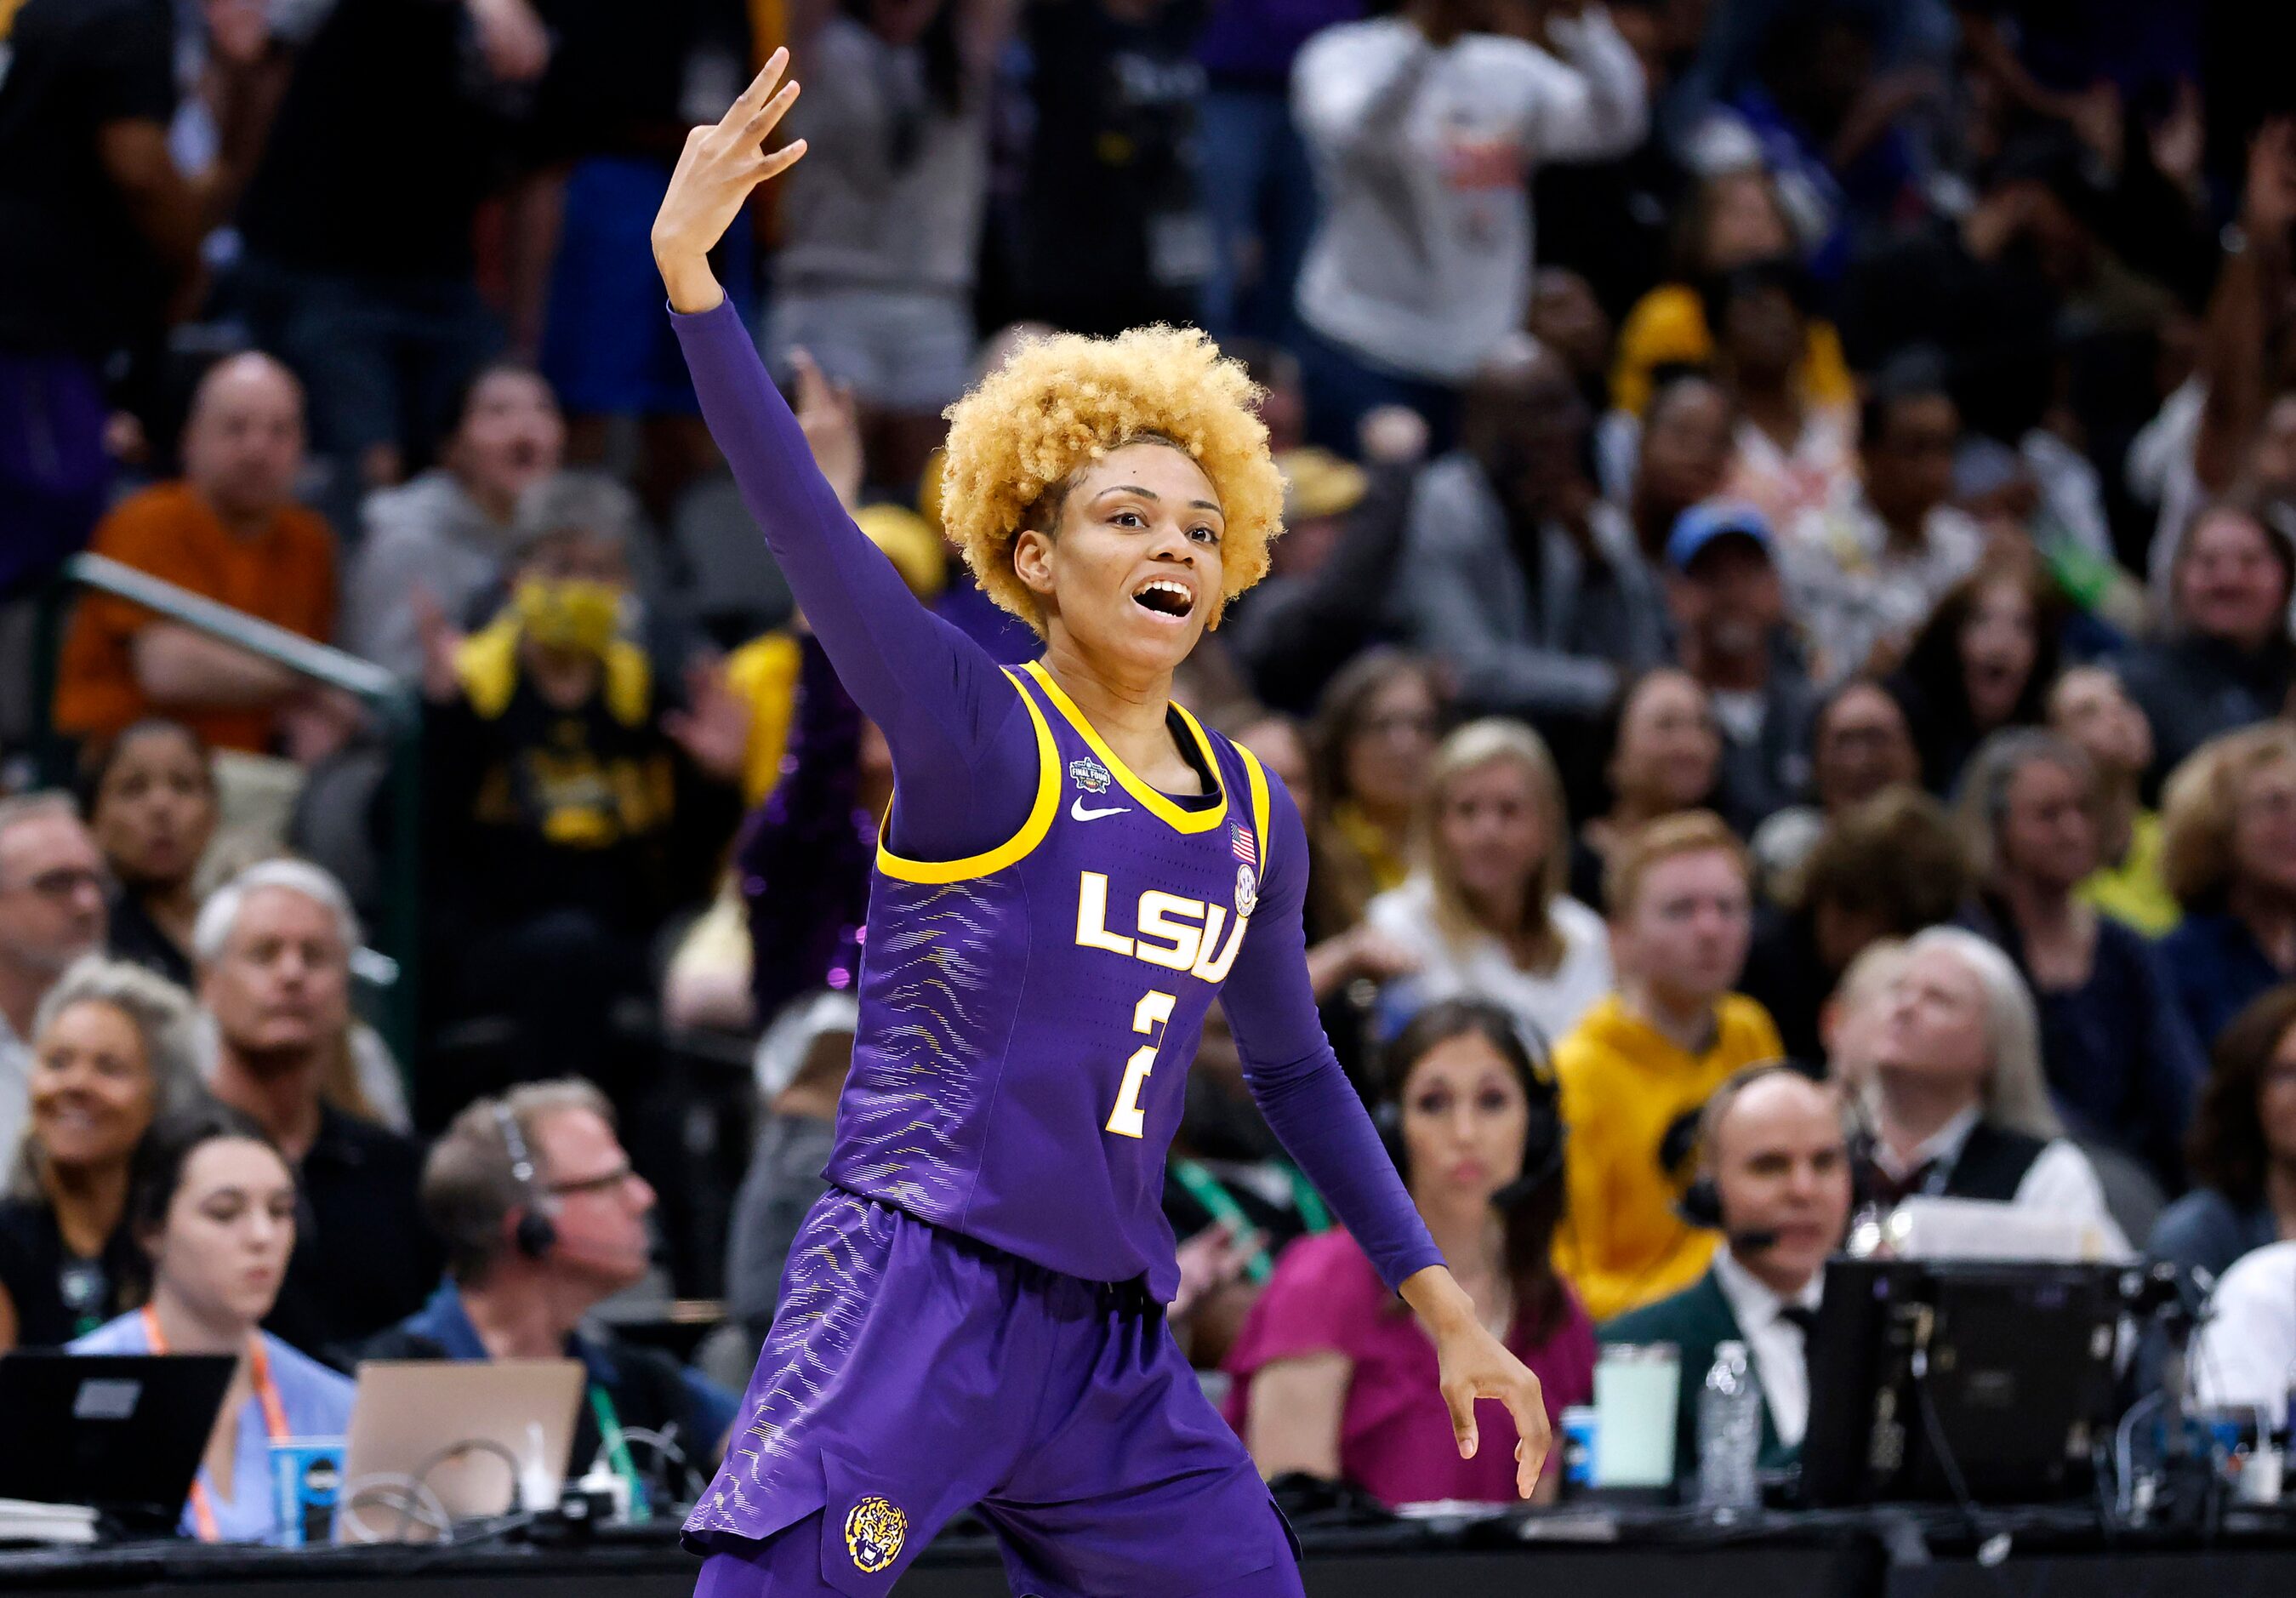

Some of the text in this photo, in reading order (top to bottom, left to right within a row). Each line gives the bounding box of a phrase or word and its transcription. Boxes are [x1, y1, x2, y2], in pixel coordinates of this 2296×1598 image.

[1073, 768, 1108, 782] FINAL FOUR
[1075, 870, 1249, 984] LSU
[1105, 990, 1177, 1139] 2
